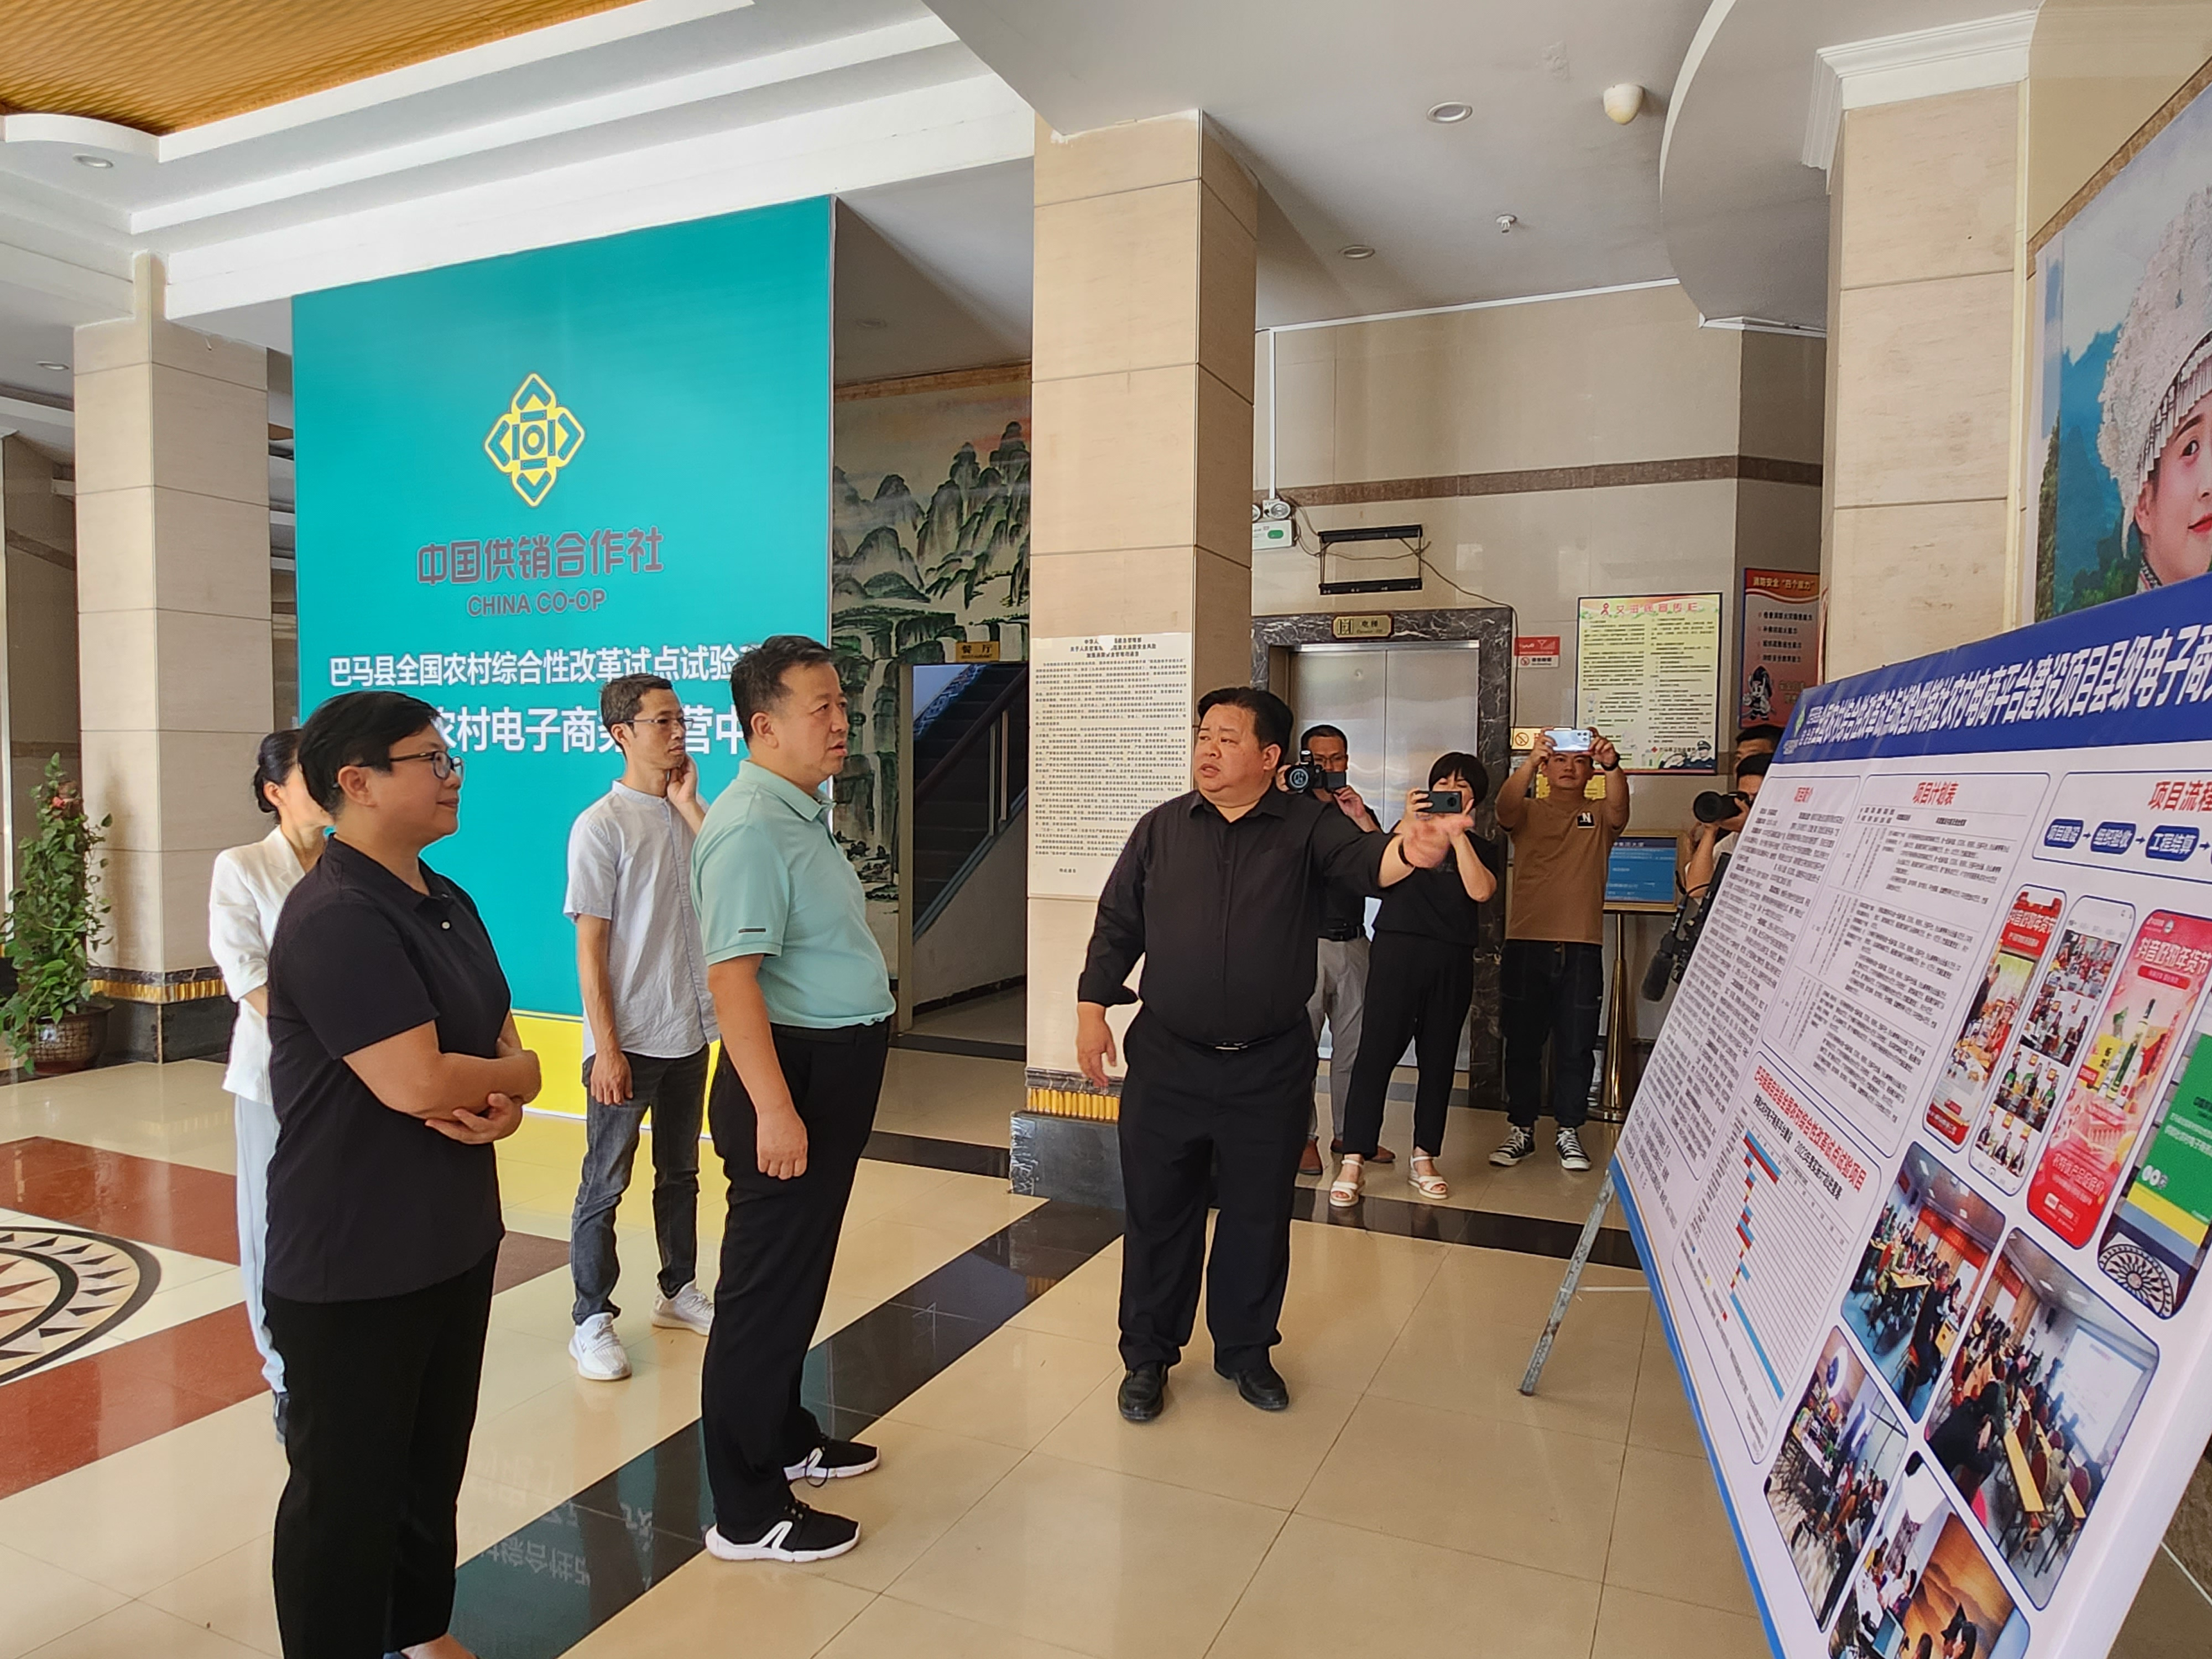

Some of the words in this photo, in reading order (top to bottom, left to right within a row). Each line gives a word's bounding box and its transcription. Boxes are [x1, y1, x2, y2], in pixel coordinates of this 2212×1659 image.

[417, 526, 663, 585] 中国供销合作社
[468, 594, 531, 617] CHINA
[536, 588, 606, 613] CO-OP
[330, 643, 761, 687] 巴马县全国农村综合性改革试点试验
[431, 705, 745, 755] 农村电子商营中
[1912, 781, 1959, 805] 项目计划表
[1582, 812, 1592, 823] N
[2148, 833, 2197, 854] 工程结算
